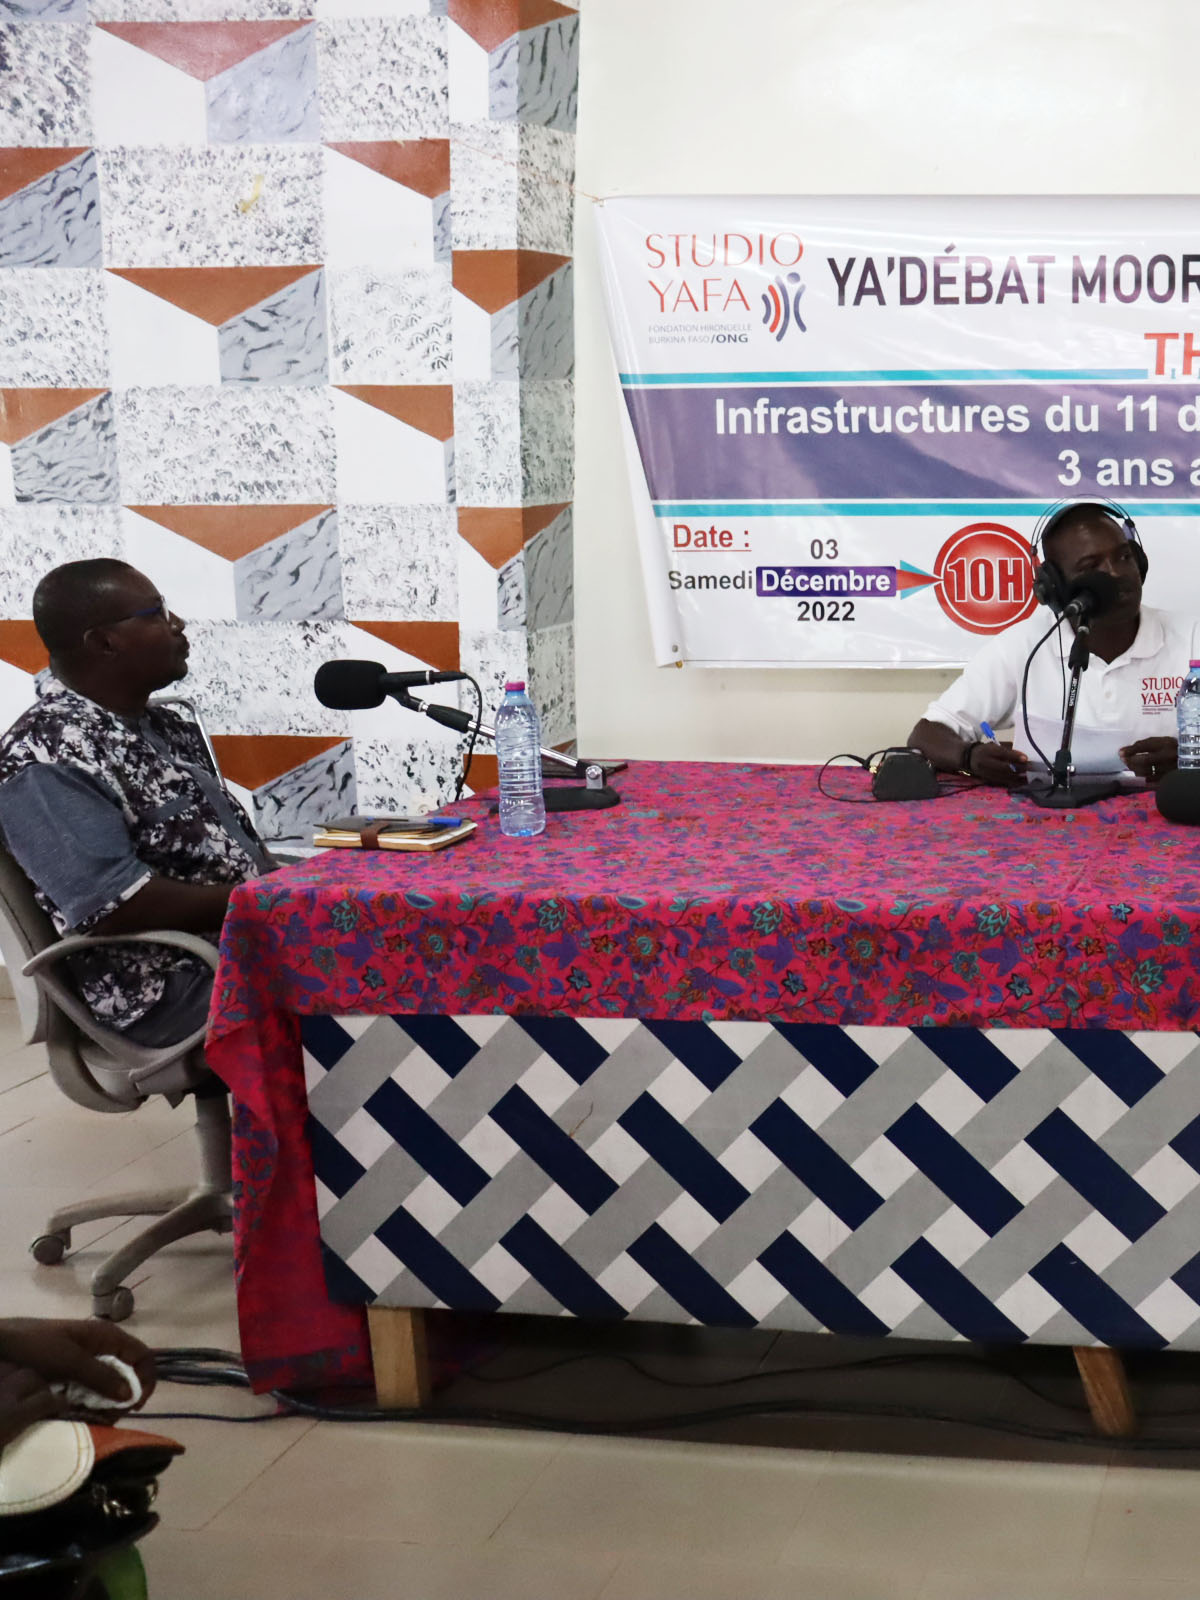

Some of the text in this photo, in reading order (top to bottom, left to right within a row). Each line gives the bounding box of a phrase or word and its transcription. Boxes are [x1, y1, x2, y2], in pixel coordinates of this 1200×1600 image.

[646, 232, 804, 269] STUDIO
[827, 242, 1055, 306] YA'DÉBAT
[648, 278, 751, 313] YAFA
[649, 323, 752, 334] FONDATION HIRONDELLE
[716, 397, 1030, 434] Infrastructures
[1045, 395, 1099, 432] du
[1117, 396, 1158, 432] 11
[1057, 449, 1082, 486] 3
[1096, 457, 1174, 486] ans
[673, 525, 734, 547] Date
[811, 539, 838, 560] 03
[669, 569, 891, 592] Samedi Décembre
[947, 557, 1026, 602] 10H
[797, 601, 855, 621] 2022
[1142, 677, 1184, 691] STUDIO
[1141, 692, 1173, 705] YAFA
